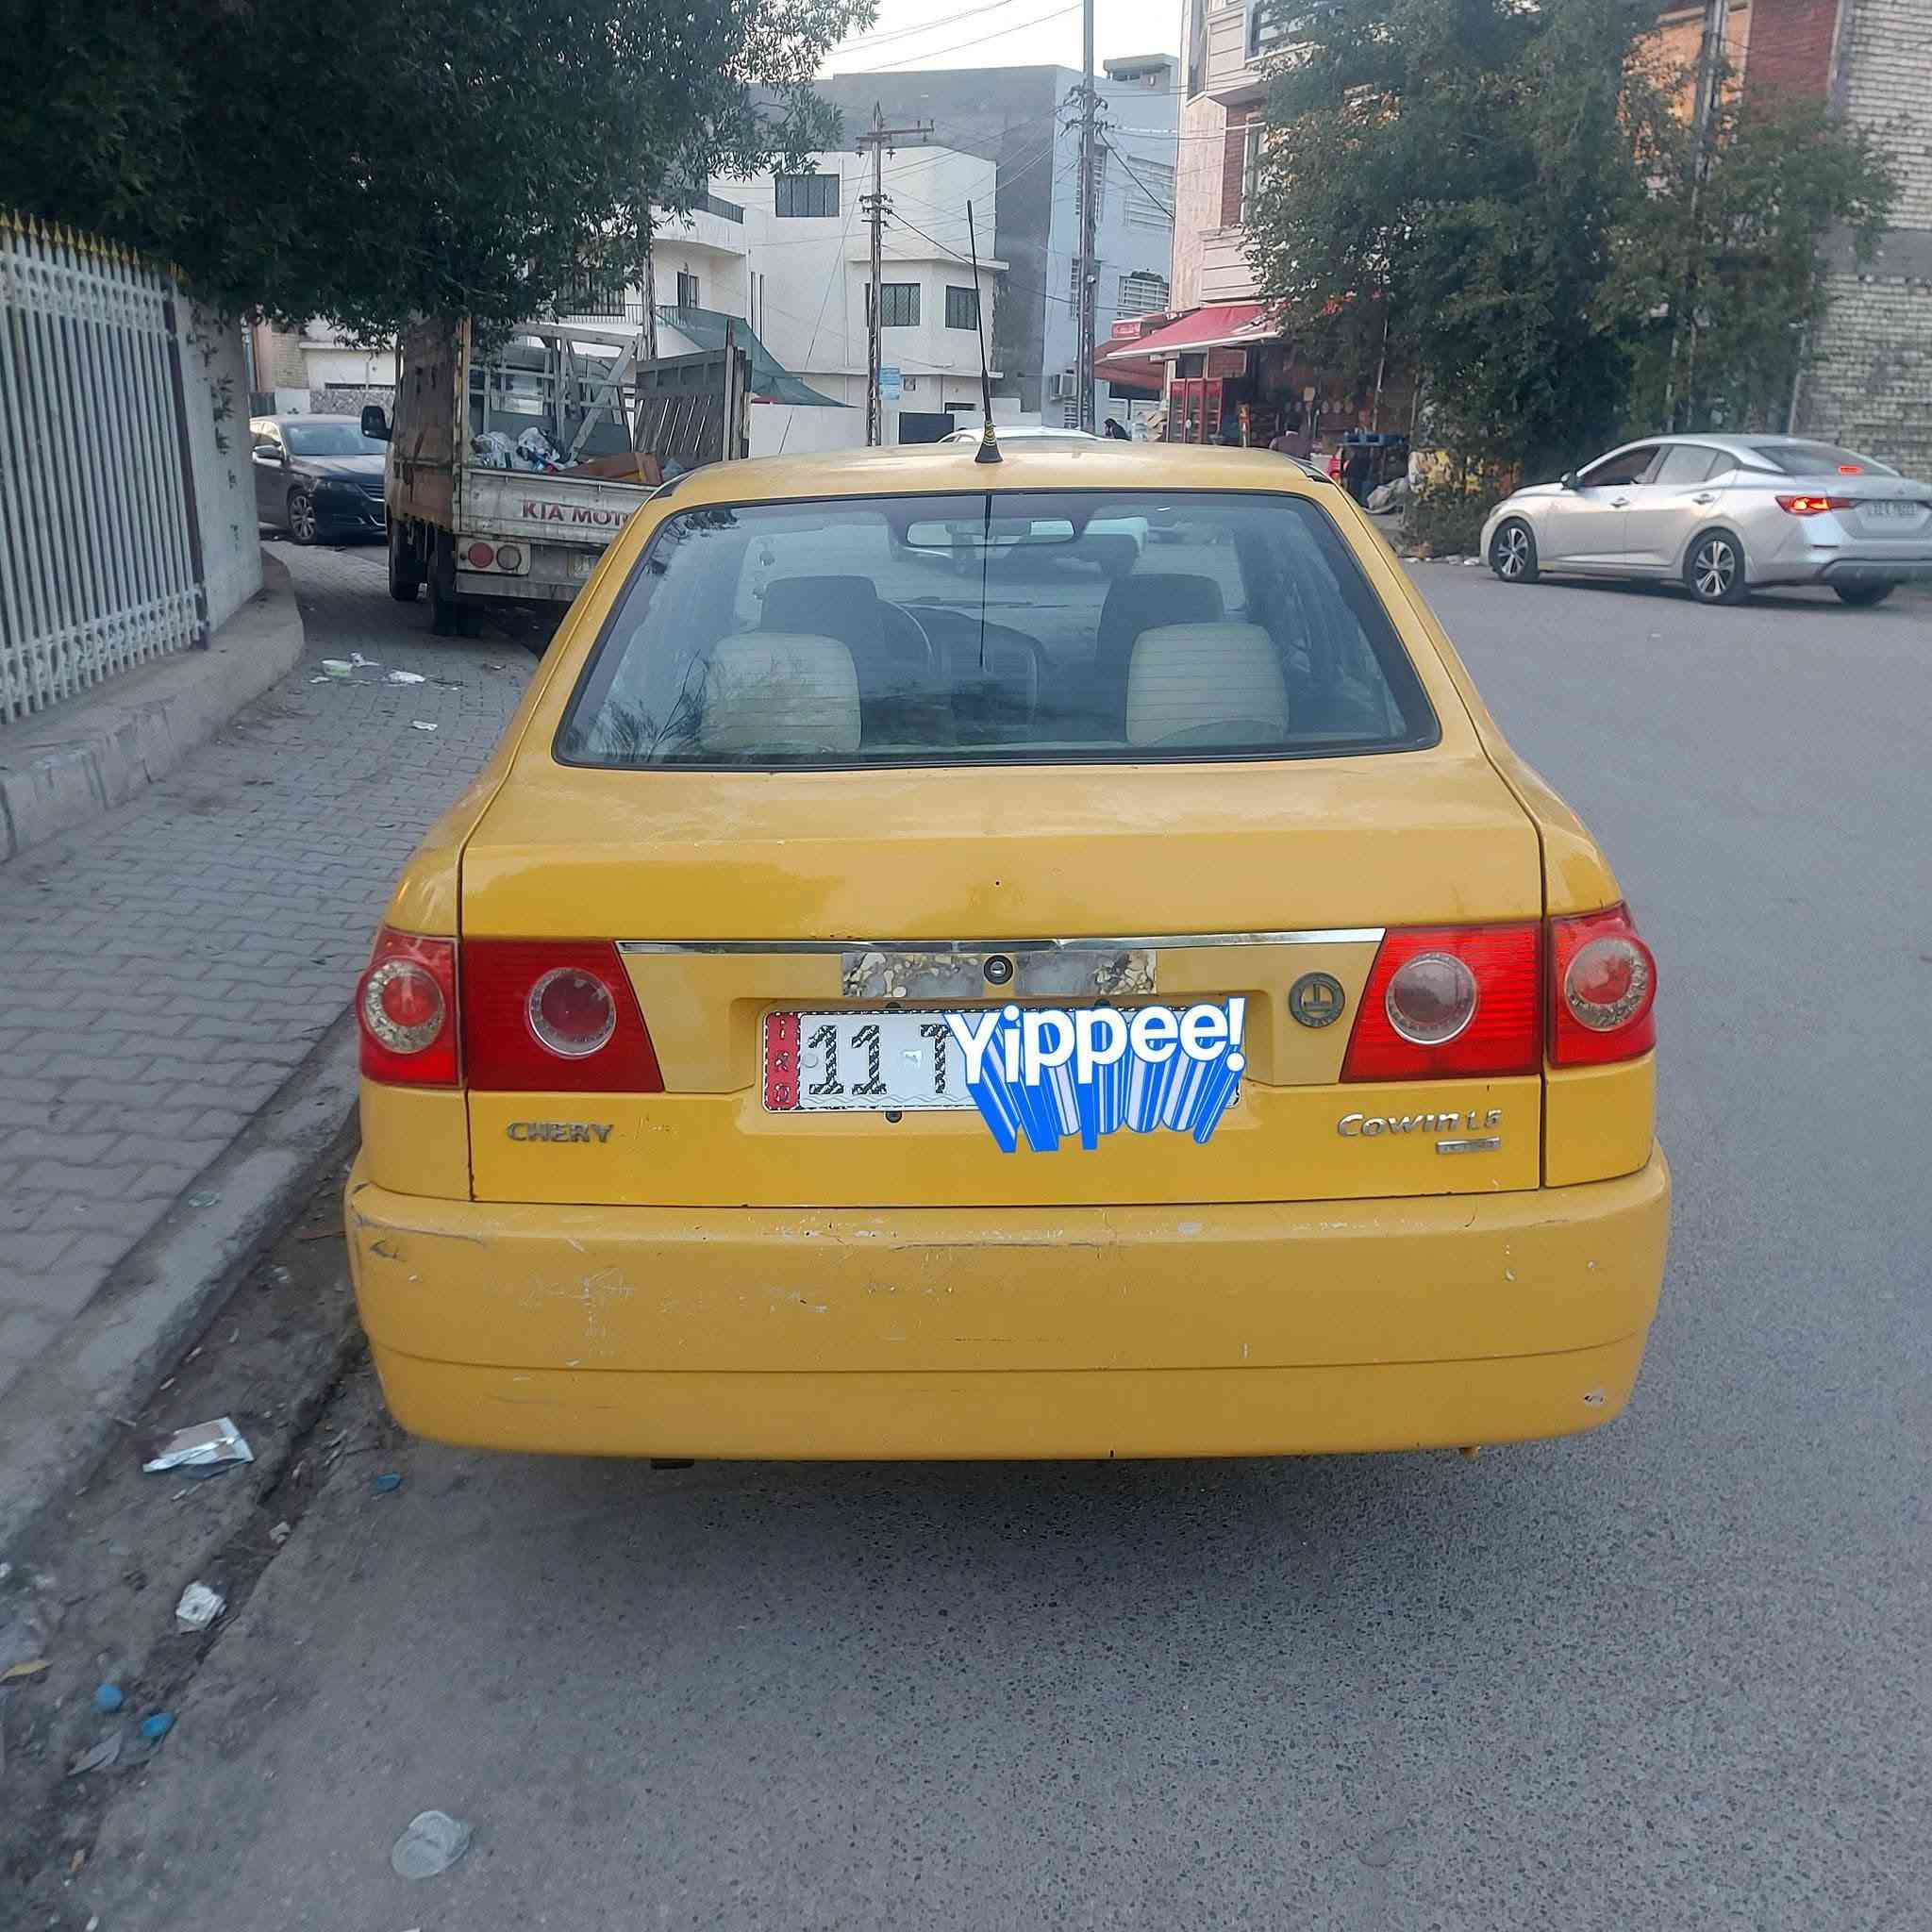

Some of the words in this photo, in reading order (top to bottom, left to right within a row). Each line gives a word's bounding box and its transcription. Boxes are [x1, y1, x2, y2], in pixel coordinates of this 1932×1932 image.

[522, 502, 564, 521] KIA
[808, 1024, 889, 1095] 11
[507, 1122, 615, 1143] CHERY
